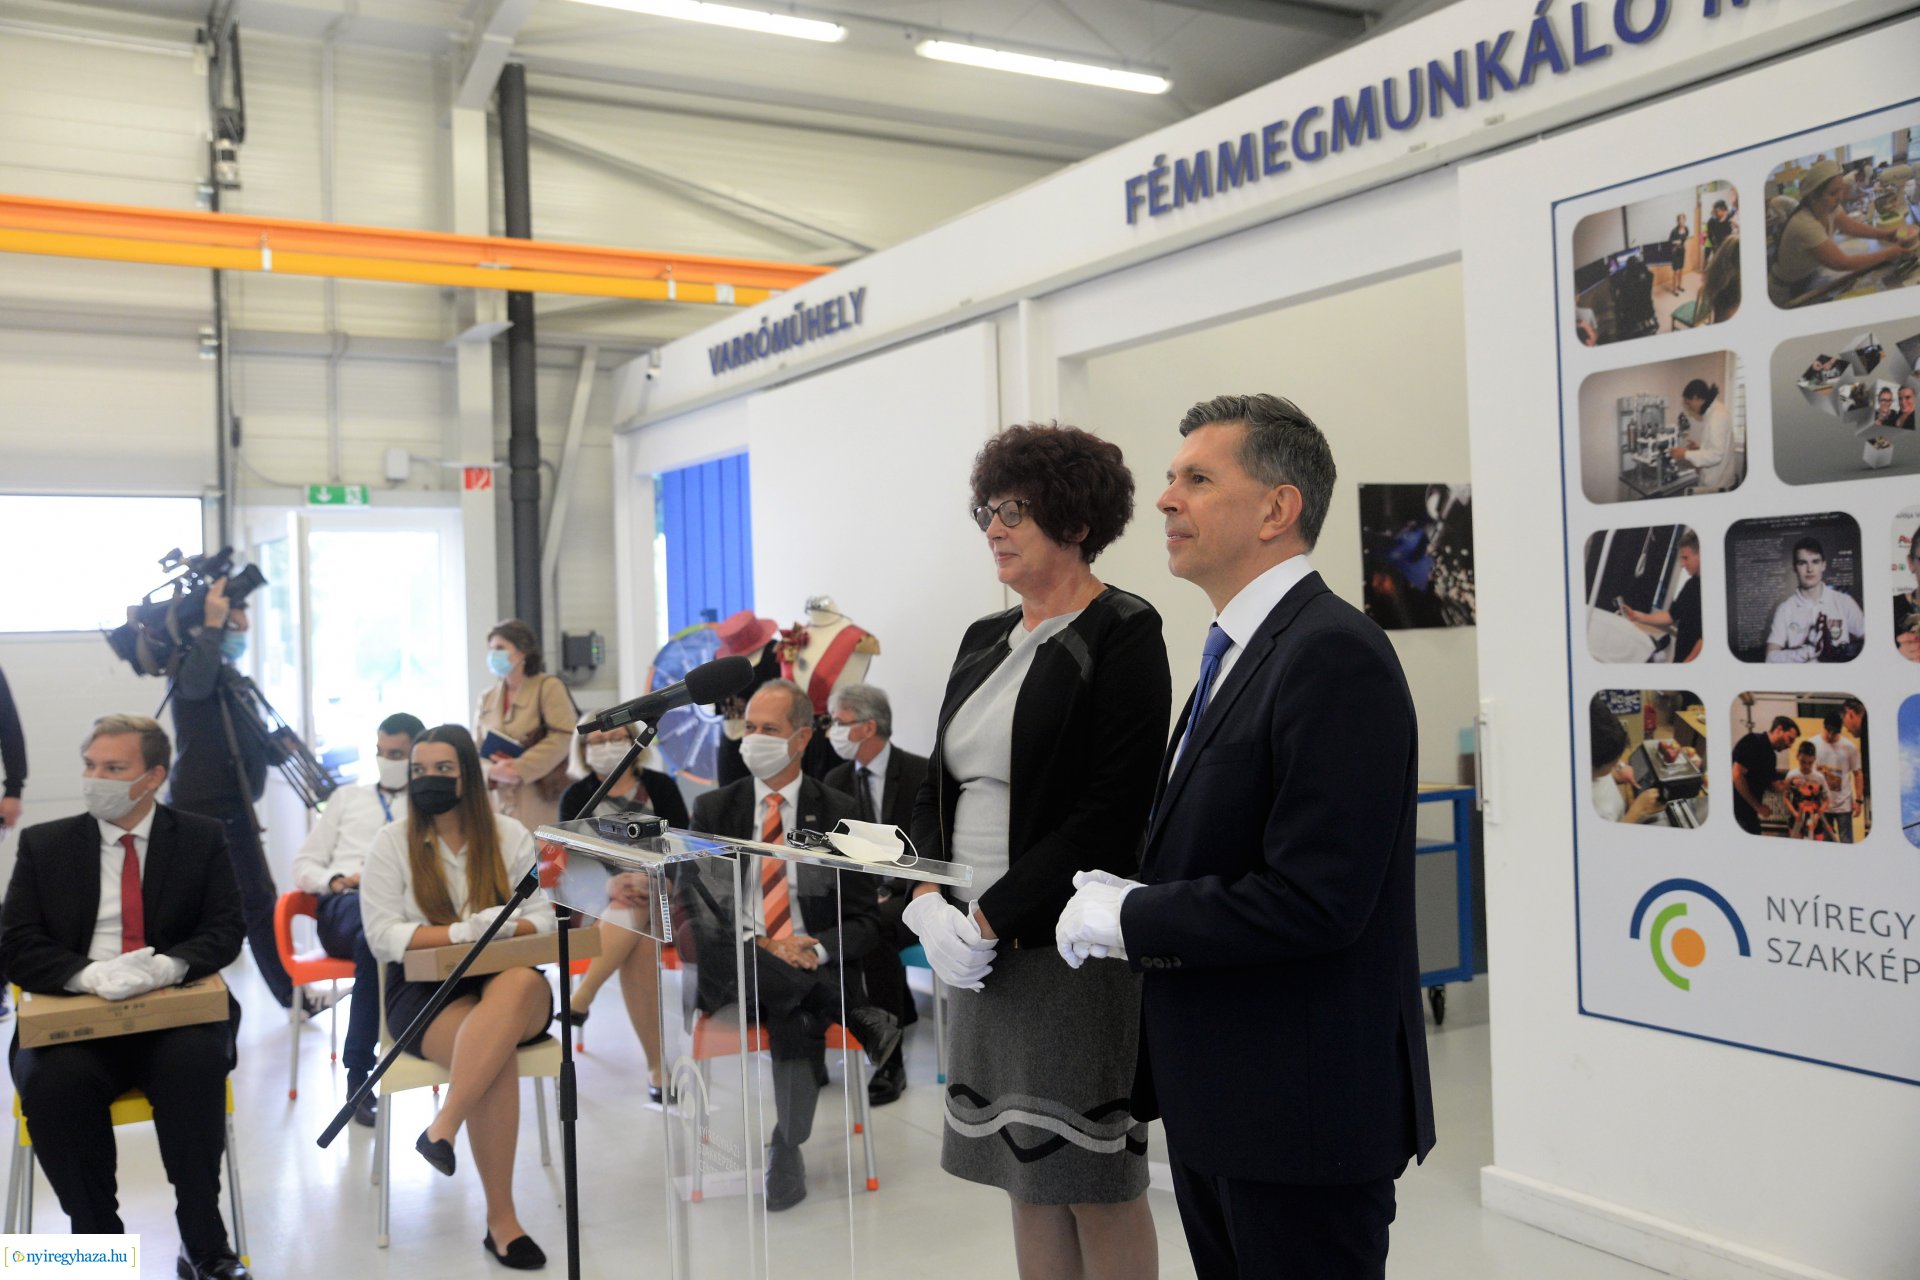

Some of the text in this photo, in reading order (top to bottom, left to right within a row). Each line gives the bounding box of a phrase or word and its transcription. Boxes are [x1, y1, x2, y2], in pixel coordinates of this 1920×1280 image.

[708, 287, 866, 376] VARRÓMŰHELY
[1766, 894, 1916, 940] NYÍREGY
[1767, 937, 1920, 984] SZAKKÉP
